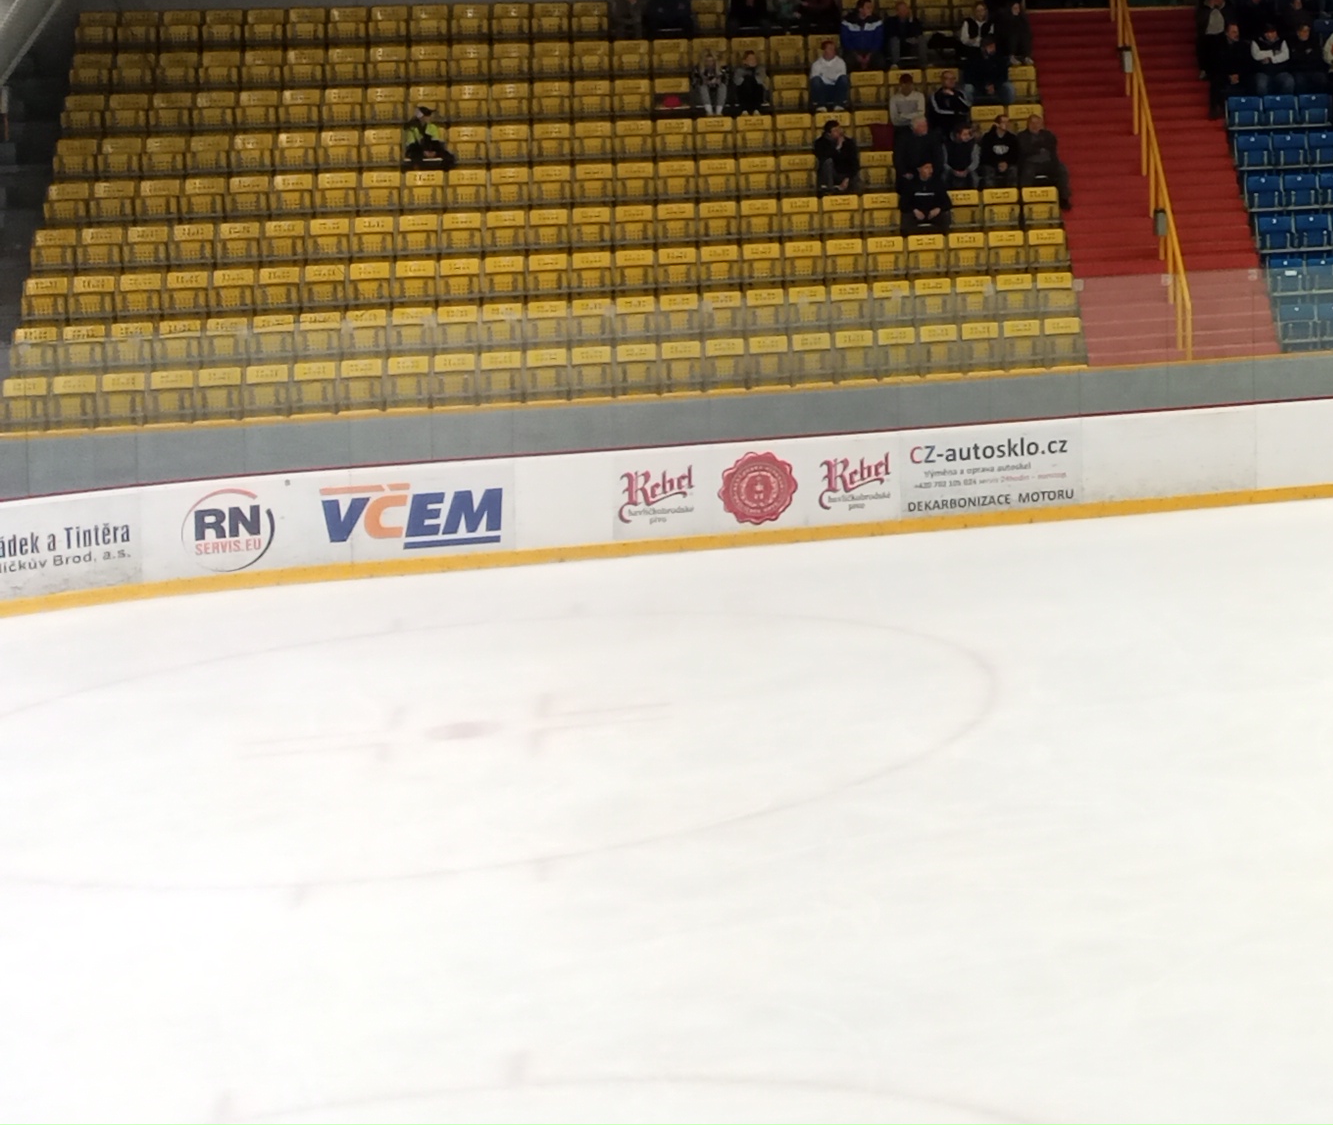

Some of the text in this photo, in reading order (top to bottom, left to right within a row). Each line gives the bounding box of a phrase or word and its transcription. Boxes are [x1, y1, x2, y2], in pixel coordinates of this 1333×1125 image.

[909, 437, 1068, 464] CZ-autosklo.cz
[618, 464, 695, 521] Rebel
[818, 451, 891, 508] Rebel
[319, 482, 504, 543] VČEM
[907, 488, 1074, 512] DEKARBONIZACE MOTORU
[47, 533, 57, 552] a
[64, 523, 130, 550] Tintěra
[194, 504, 261, 542] RN
[103, 549, 131, 561] a.s.
[195, 538, 262, 556] SERVIS.EU
